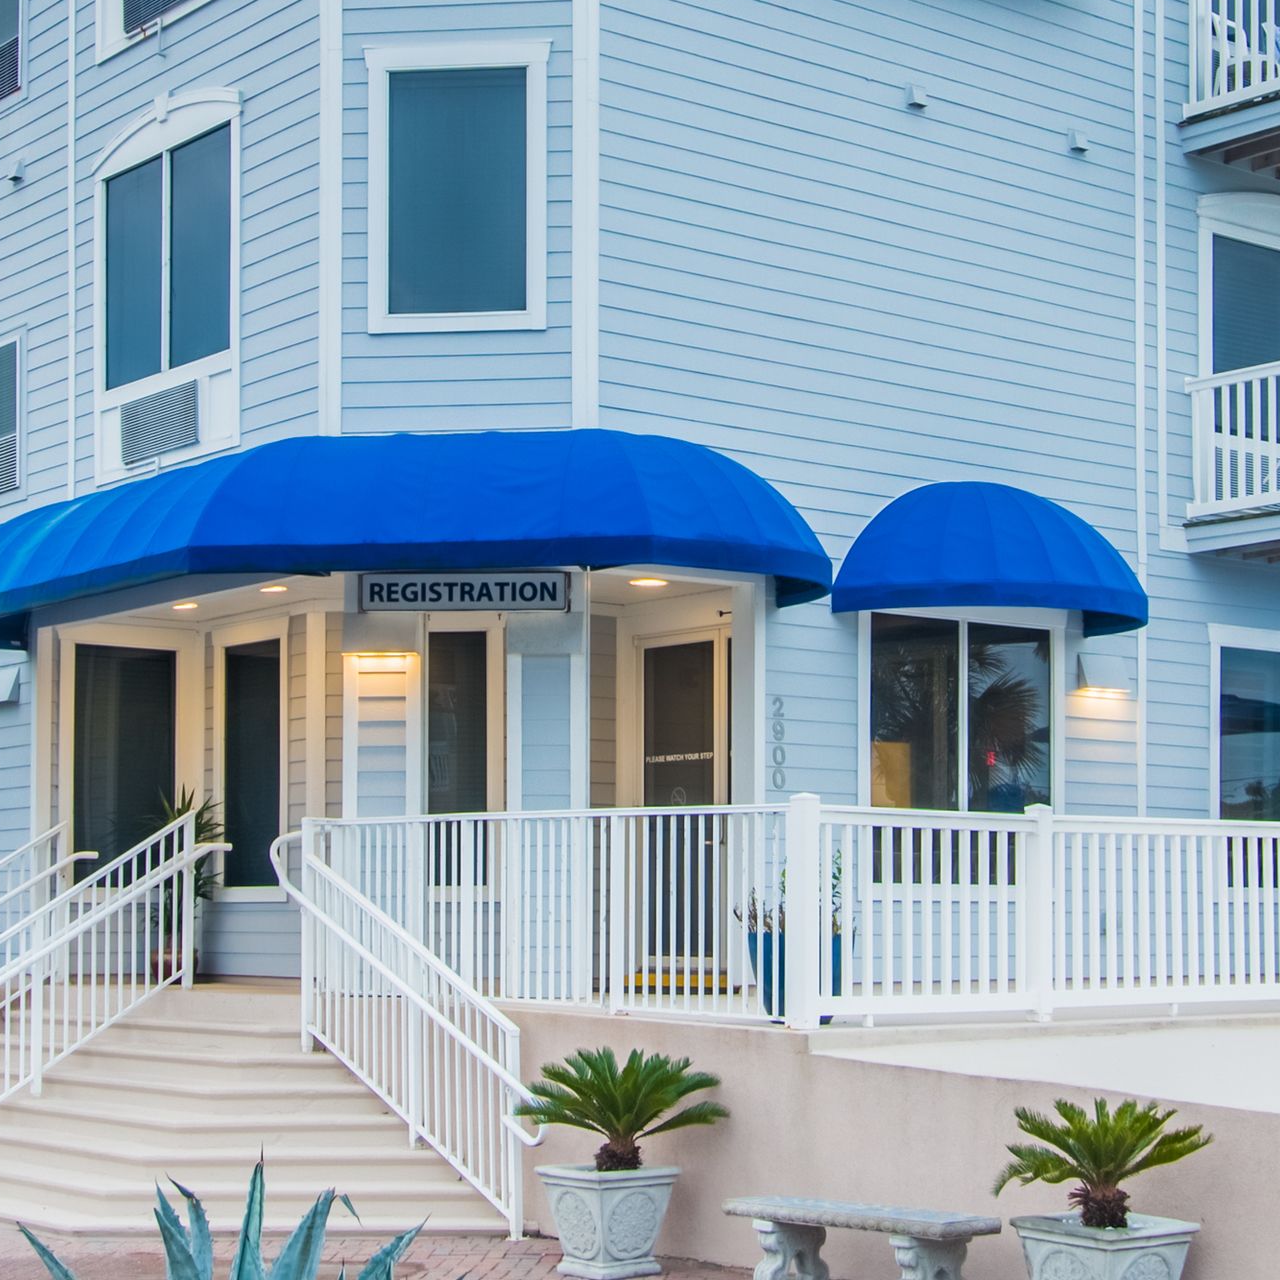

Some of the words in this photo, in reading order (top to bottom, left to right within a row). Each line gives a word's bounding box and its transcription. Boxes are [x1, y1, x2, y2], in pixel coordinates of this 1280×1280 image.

[369, 581, 558, 603] REGISTRATION
[772, 696, 786, 790] 2900
[646, 754, 665, 763] PLEASE
[666, 753, 684, 762] WATCH
[685, 752, 700, 761] YOUR
[700, 751, 714, 760] STEP
